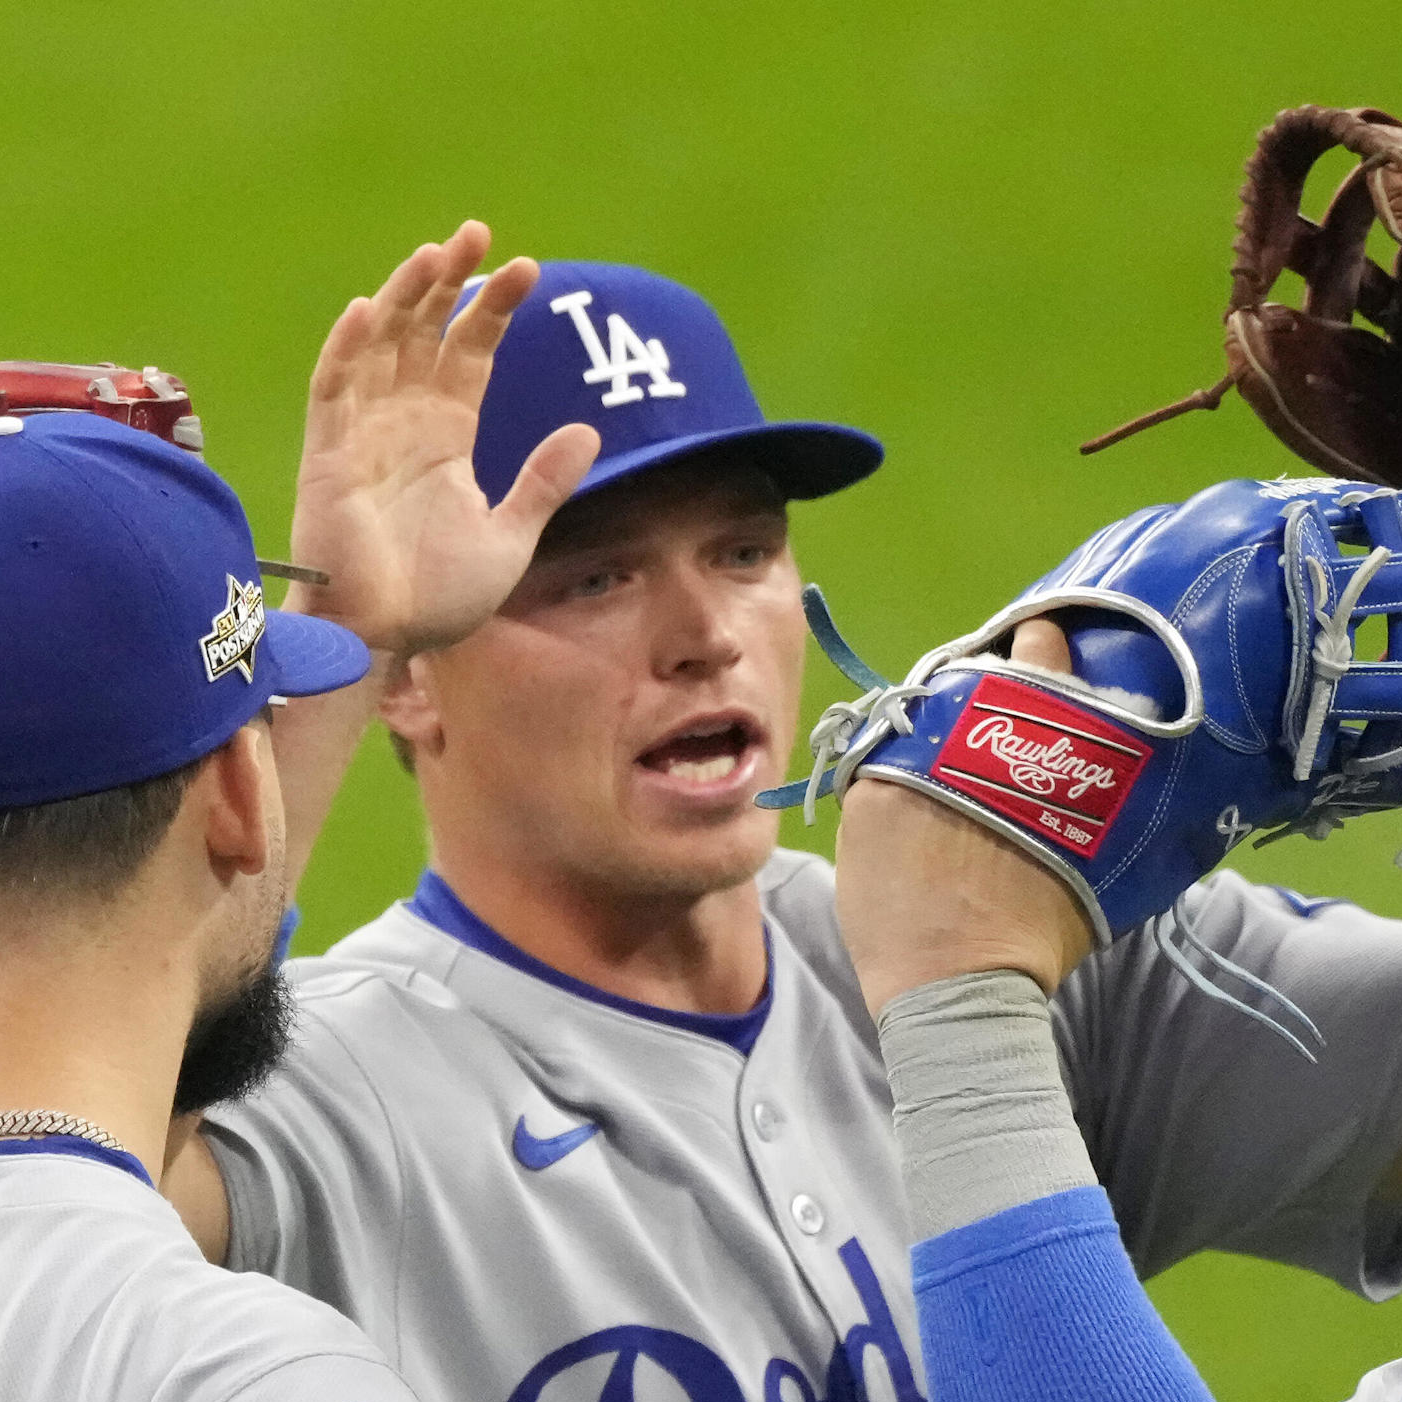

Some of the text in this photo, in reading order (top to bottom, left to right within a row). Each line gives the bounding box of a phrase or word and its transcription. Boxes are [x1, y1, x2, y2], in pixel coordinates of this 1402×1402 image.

[550, 291, 686, 407] LA
[966, 716, 1116, 799] Rawlings
[1039, 811, 1094, 845] Est. 1887
